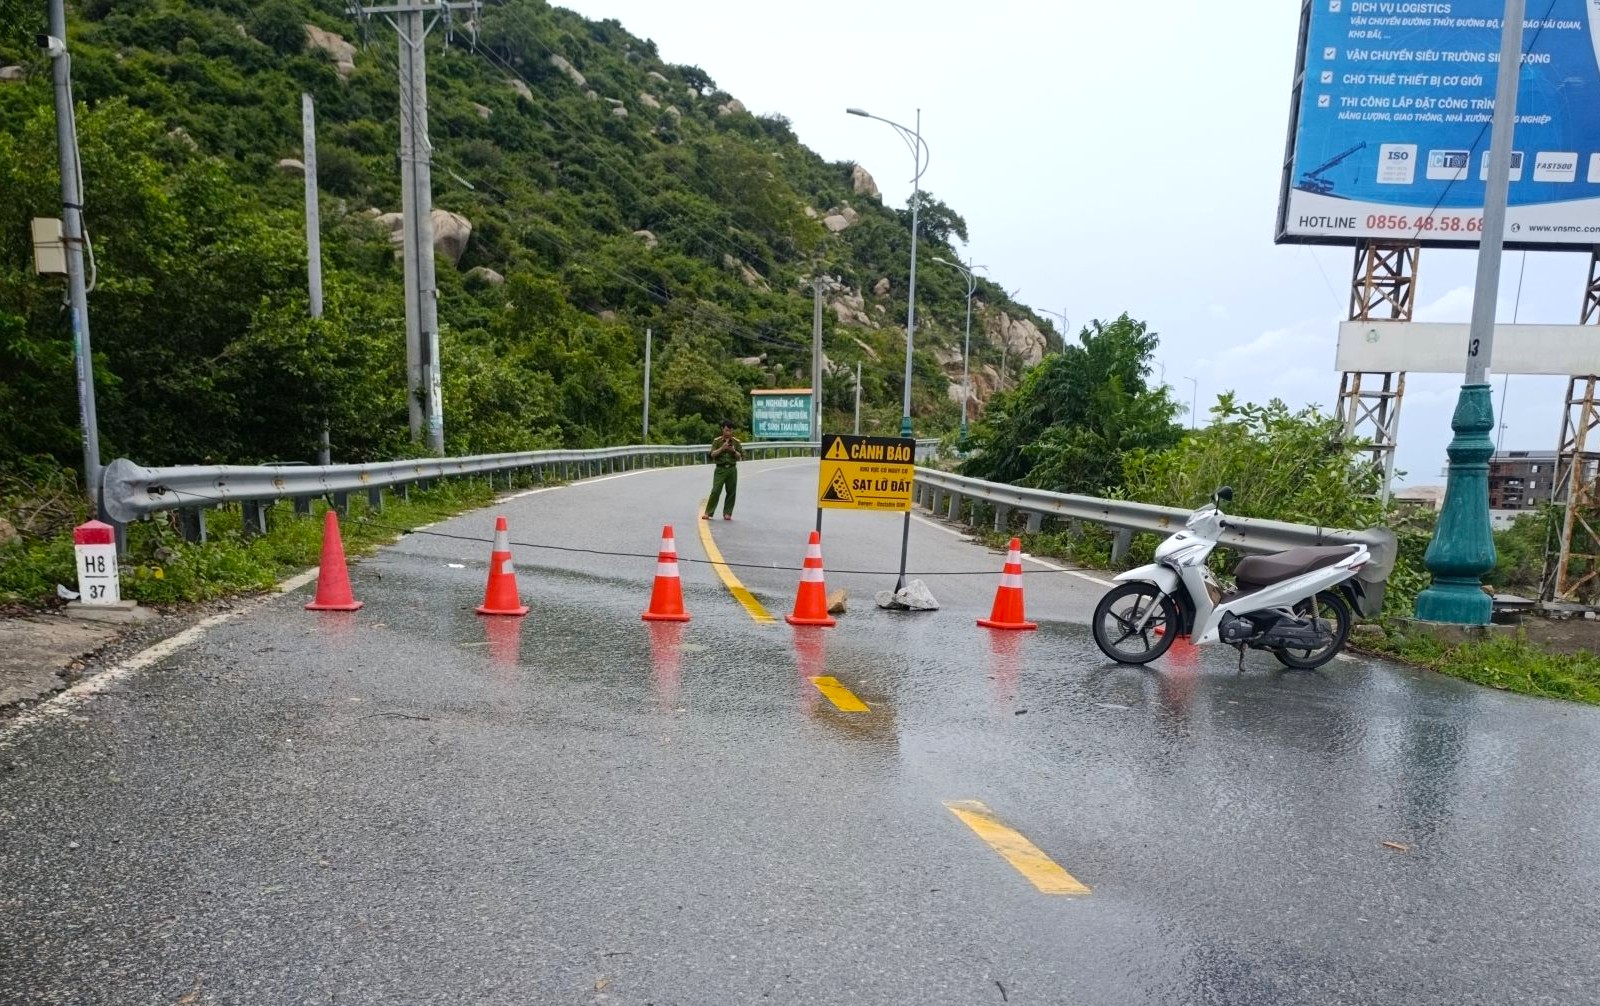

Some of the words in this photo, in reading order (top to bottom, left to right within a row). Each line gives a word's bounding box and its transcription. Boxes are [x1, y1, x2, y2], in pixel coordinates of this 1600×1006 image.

[1396, 3, 1451, 13] LOGISTICS
[1348, 30, 1366, 38] KHO
[1415, 50, 1439, 61] SIÊU
[1343, 74, 1365, 84] CHO
[1367, 73, 1396, 85] THUÊ
[1398, 73, 1428, 86] THIẾT
[1341, 96, 1358, 107] THI
[1360, 95, 1390, 107] CÔNG
[1438, 97, 1468, 109] CÔNG
[1393, 112, 1413, 121] GIAO
[1388, 151, 1409, 160] ISO
[1299, 216, 1357, 229] HOTLINE
[851, 440, 883, 460] CẢNH
[887, 443, 911, 461] BÁO
[852, 478, 872, 493] SẠT
[890, 477, 911, 493] ĐẤT
[85, 555, 106, 573] H8
[90, 585, 106, 599] 37
